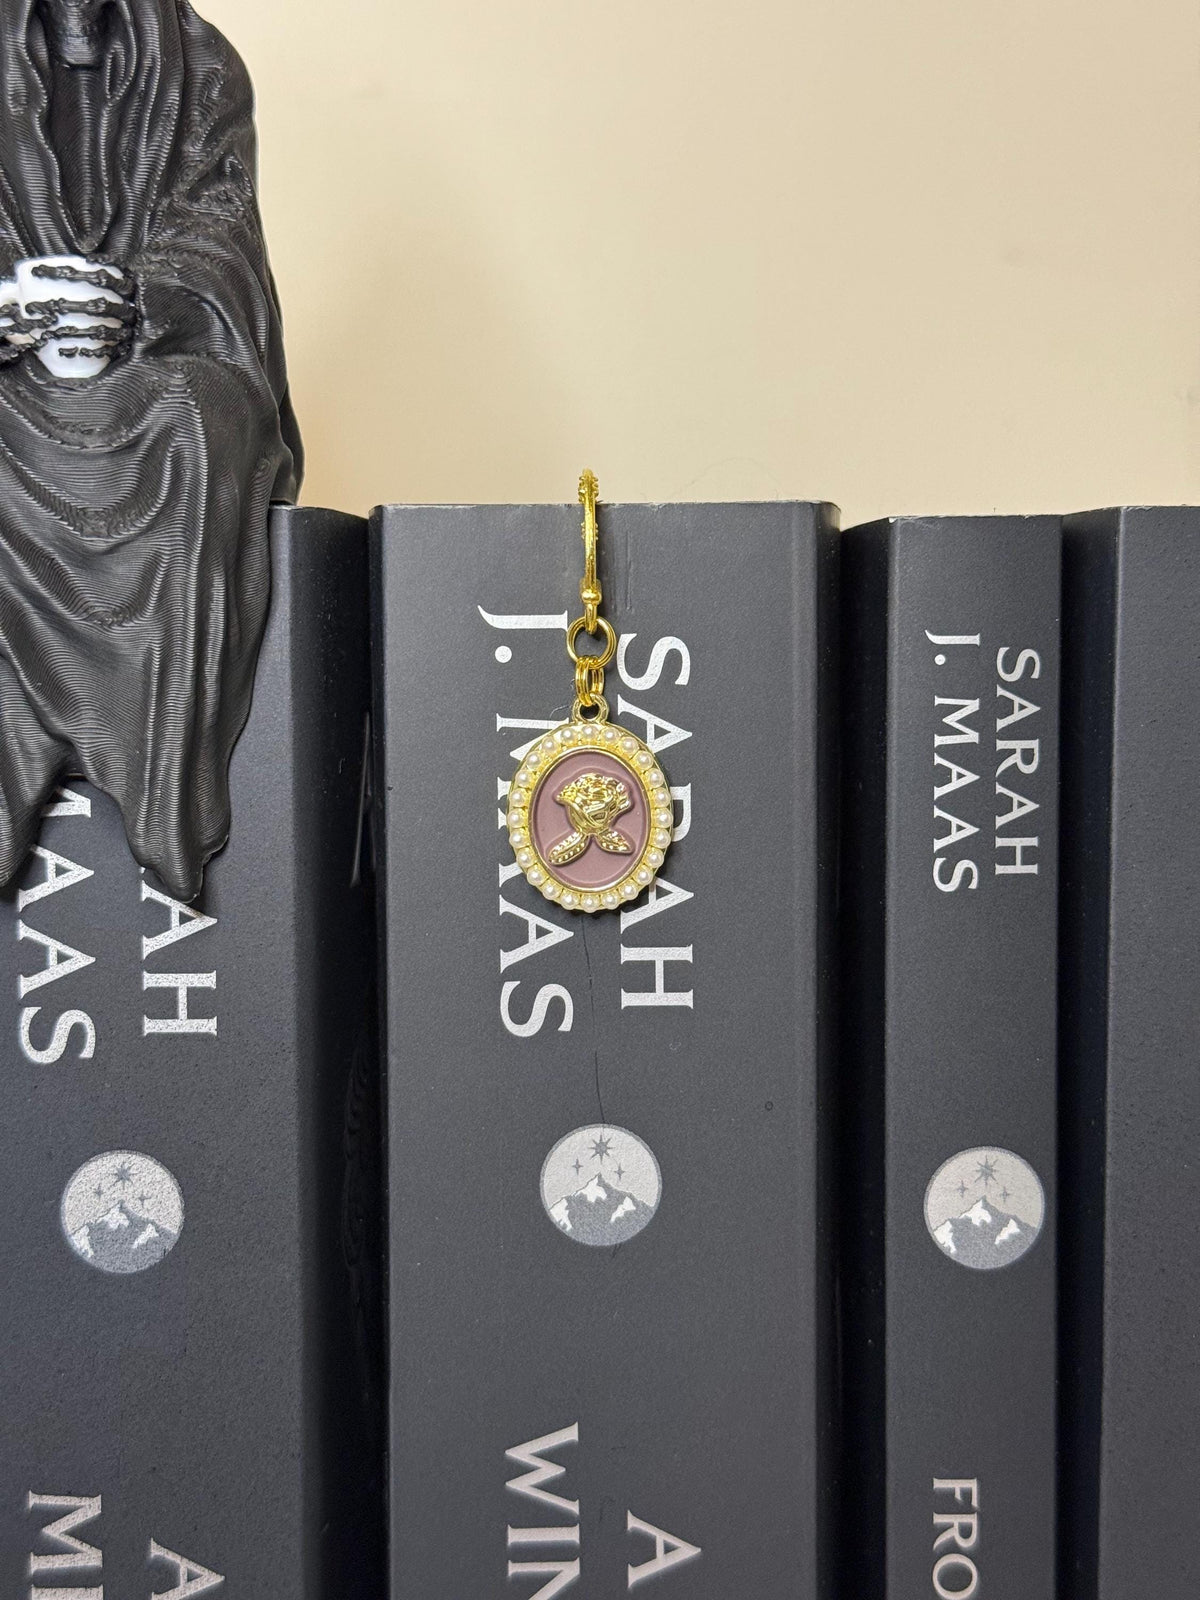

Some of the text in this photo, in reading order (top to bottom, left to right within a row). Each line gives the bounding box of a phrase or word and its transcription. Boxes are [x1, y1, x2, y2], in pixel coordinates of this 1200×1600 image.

[477, 605, 568, 664] J.
[925, 629, 981, 892] J. MAAS
[995, 646, 1041, 875] SARAH
[150, 1537, 225, 1600] A
[628, 1510, 702, 1588] A
[932, 1477, 980, 1600] FRO
